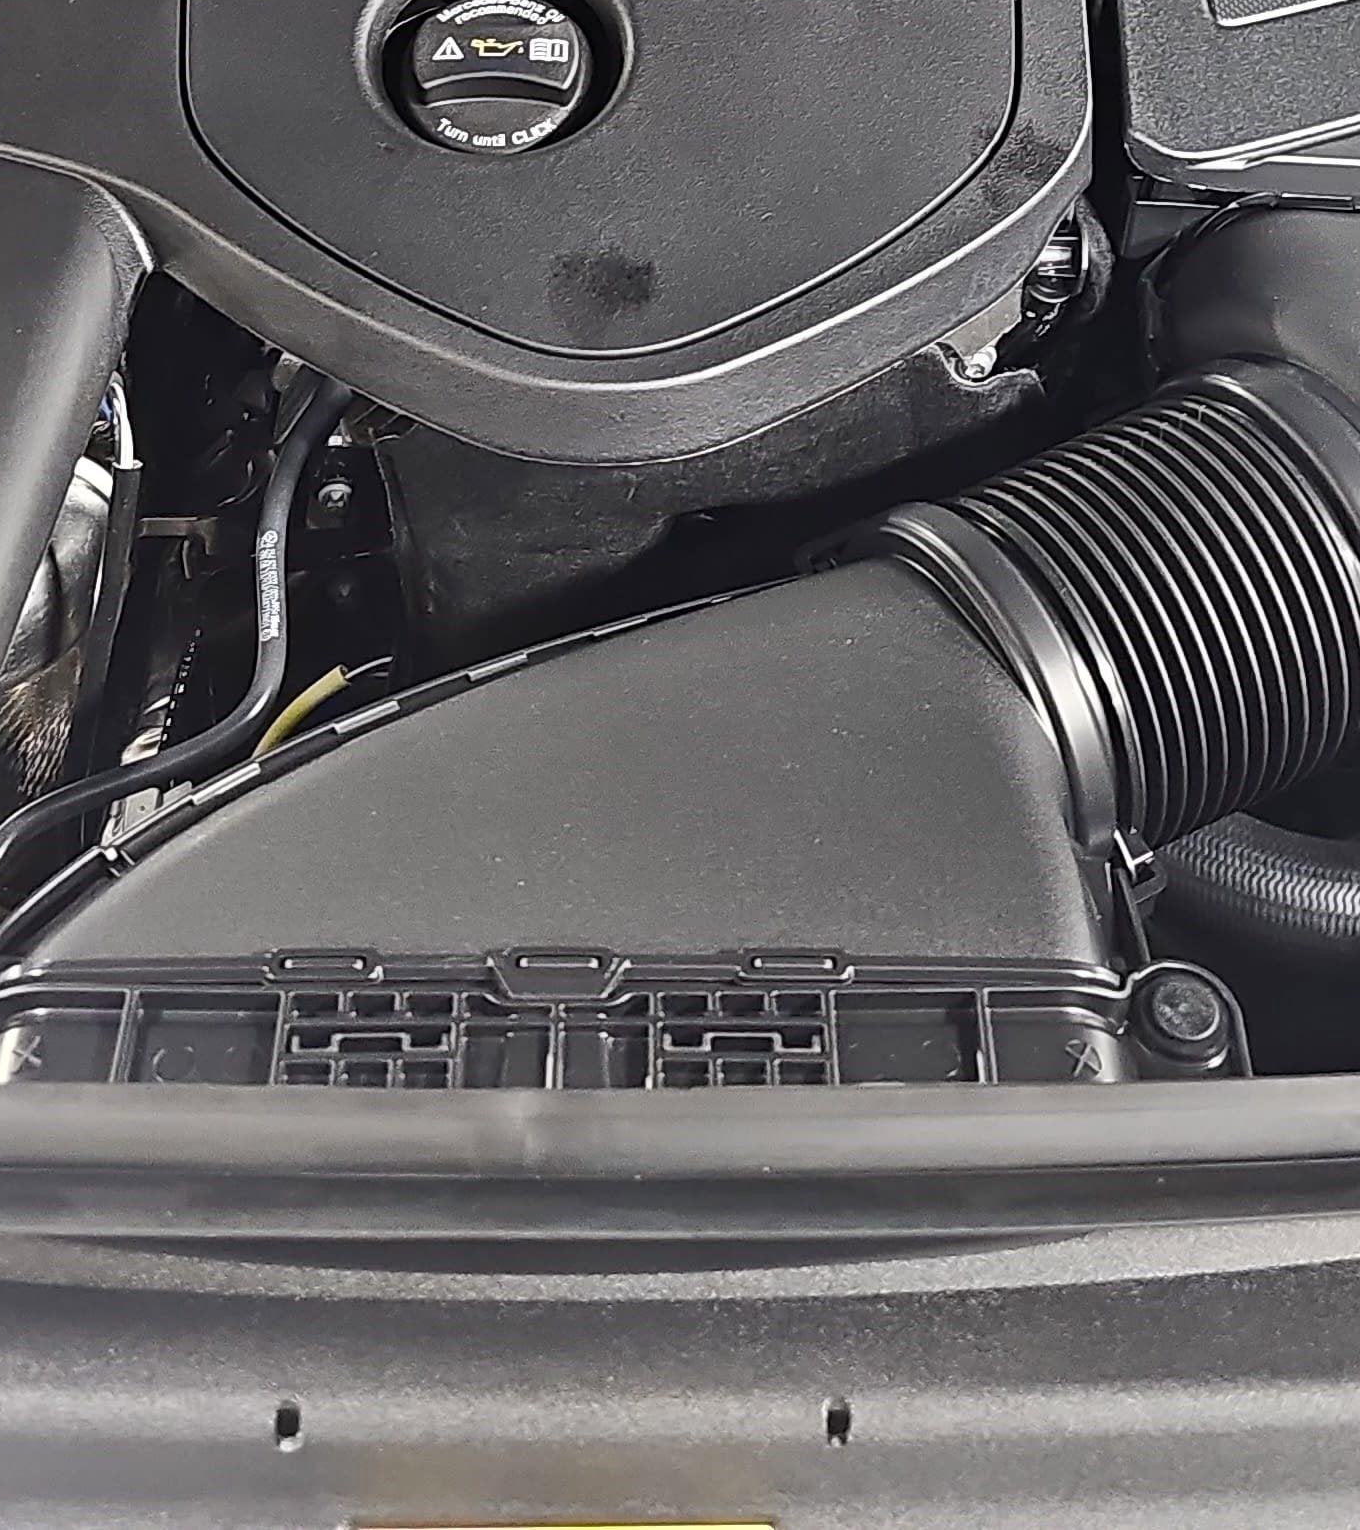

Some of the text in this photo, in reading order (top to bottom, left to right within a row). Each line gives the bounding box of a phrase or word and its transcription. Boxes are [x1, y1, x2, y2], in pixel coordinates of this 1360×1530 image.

[454, 4, 546, 25] recommended
[545, 8, 566, 23] Oil
[437, 117, 558, 147] Turn until CLICK
